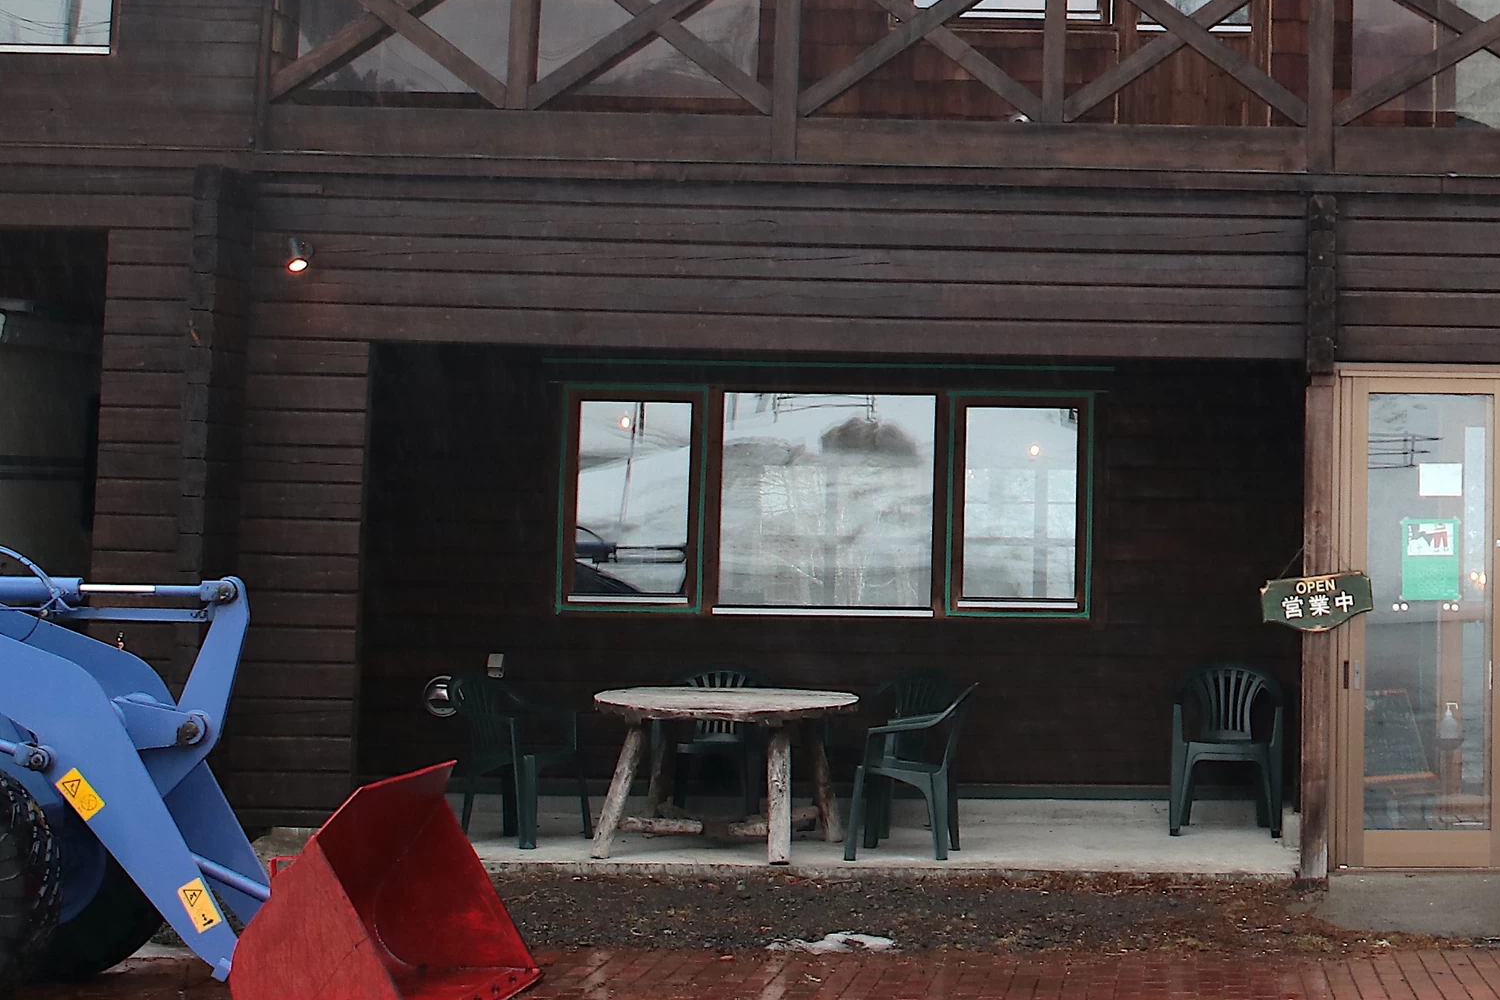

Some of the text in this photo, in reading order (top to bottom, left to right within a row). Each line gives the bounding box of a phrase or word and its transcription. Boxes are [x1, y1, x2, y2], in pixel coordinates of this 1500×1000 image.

[1296, 579, 1336, 594] OPEN
[1281, 591, 1354, 619] 営業中
